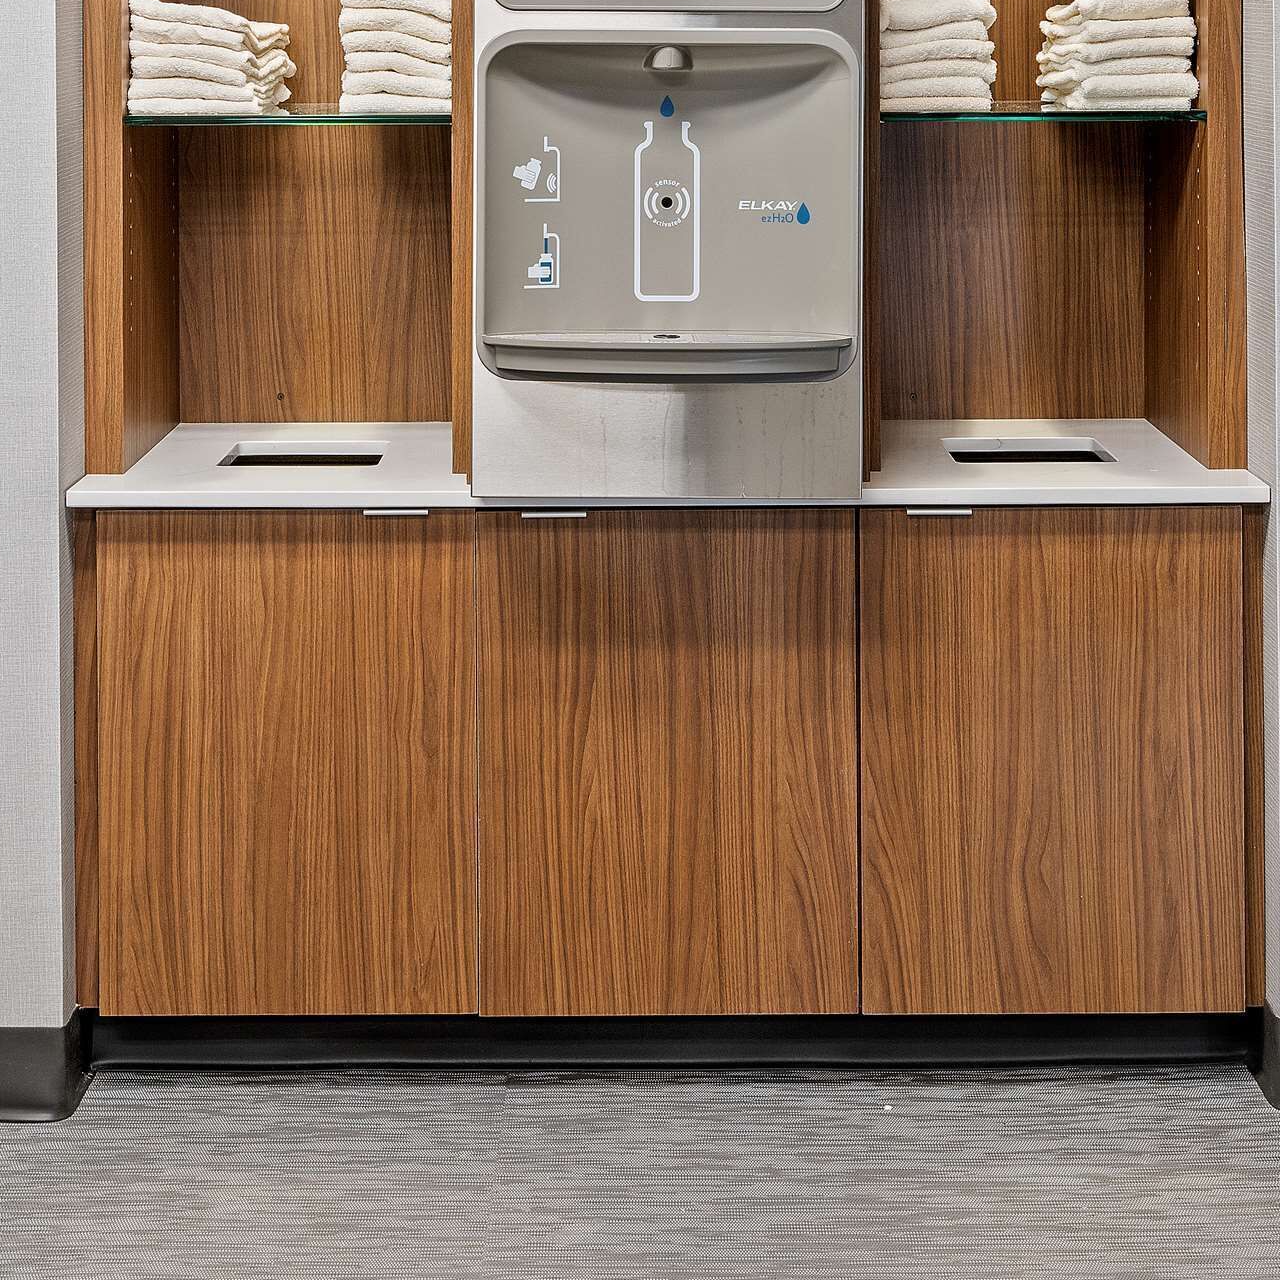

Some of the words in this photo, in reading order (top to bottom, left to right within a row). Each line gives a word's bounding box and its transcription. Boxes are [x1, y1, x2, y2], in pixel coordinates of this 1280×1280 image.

[655, 179, 680, 188] sensor
[738, 200, 798, 211] ELKAY
[652, 218, 682, 228] activated
